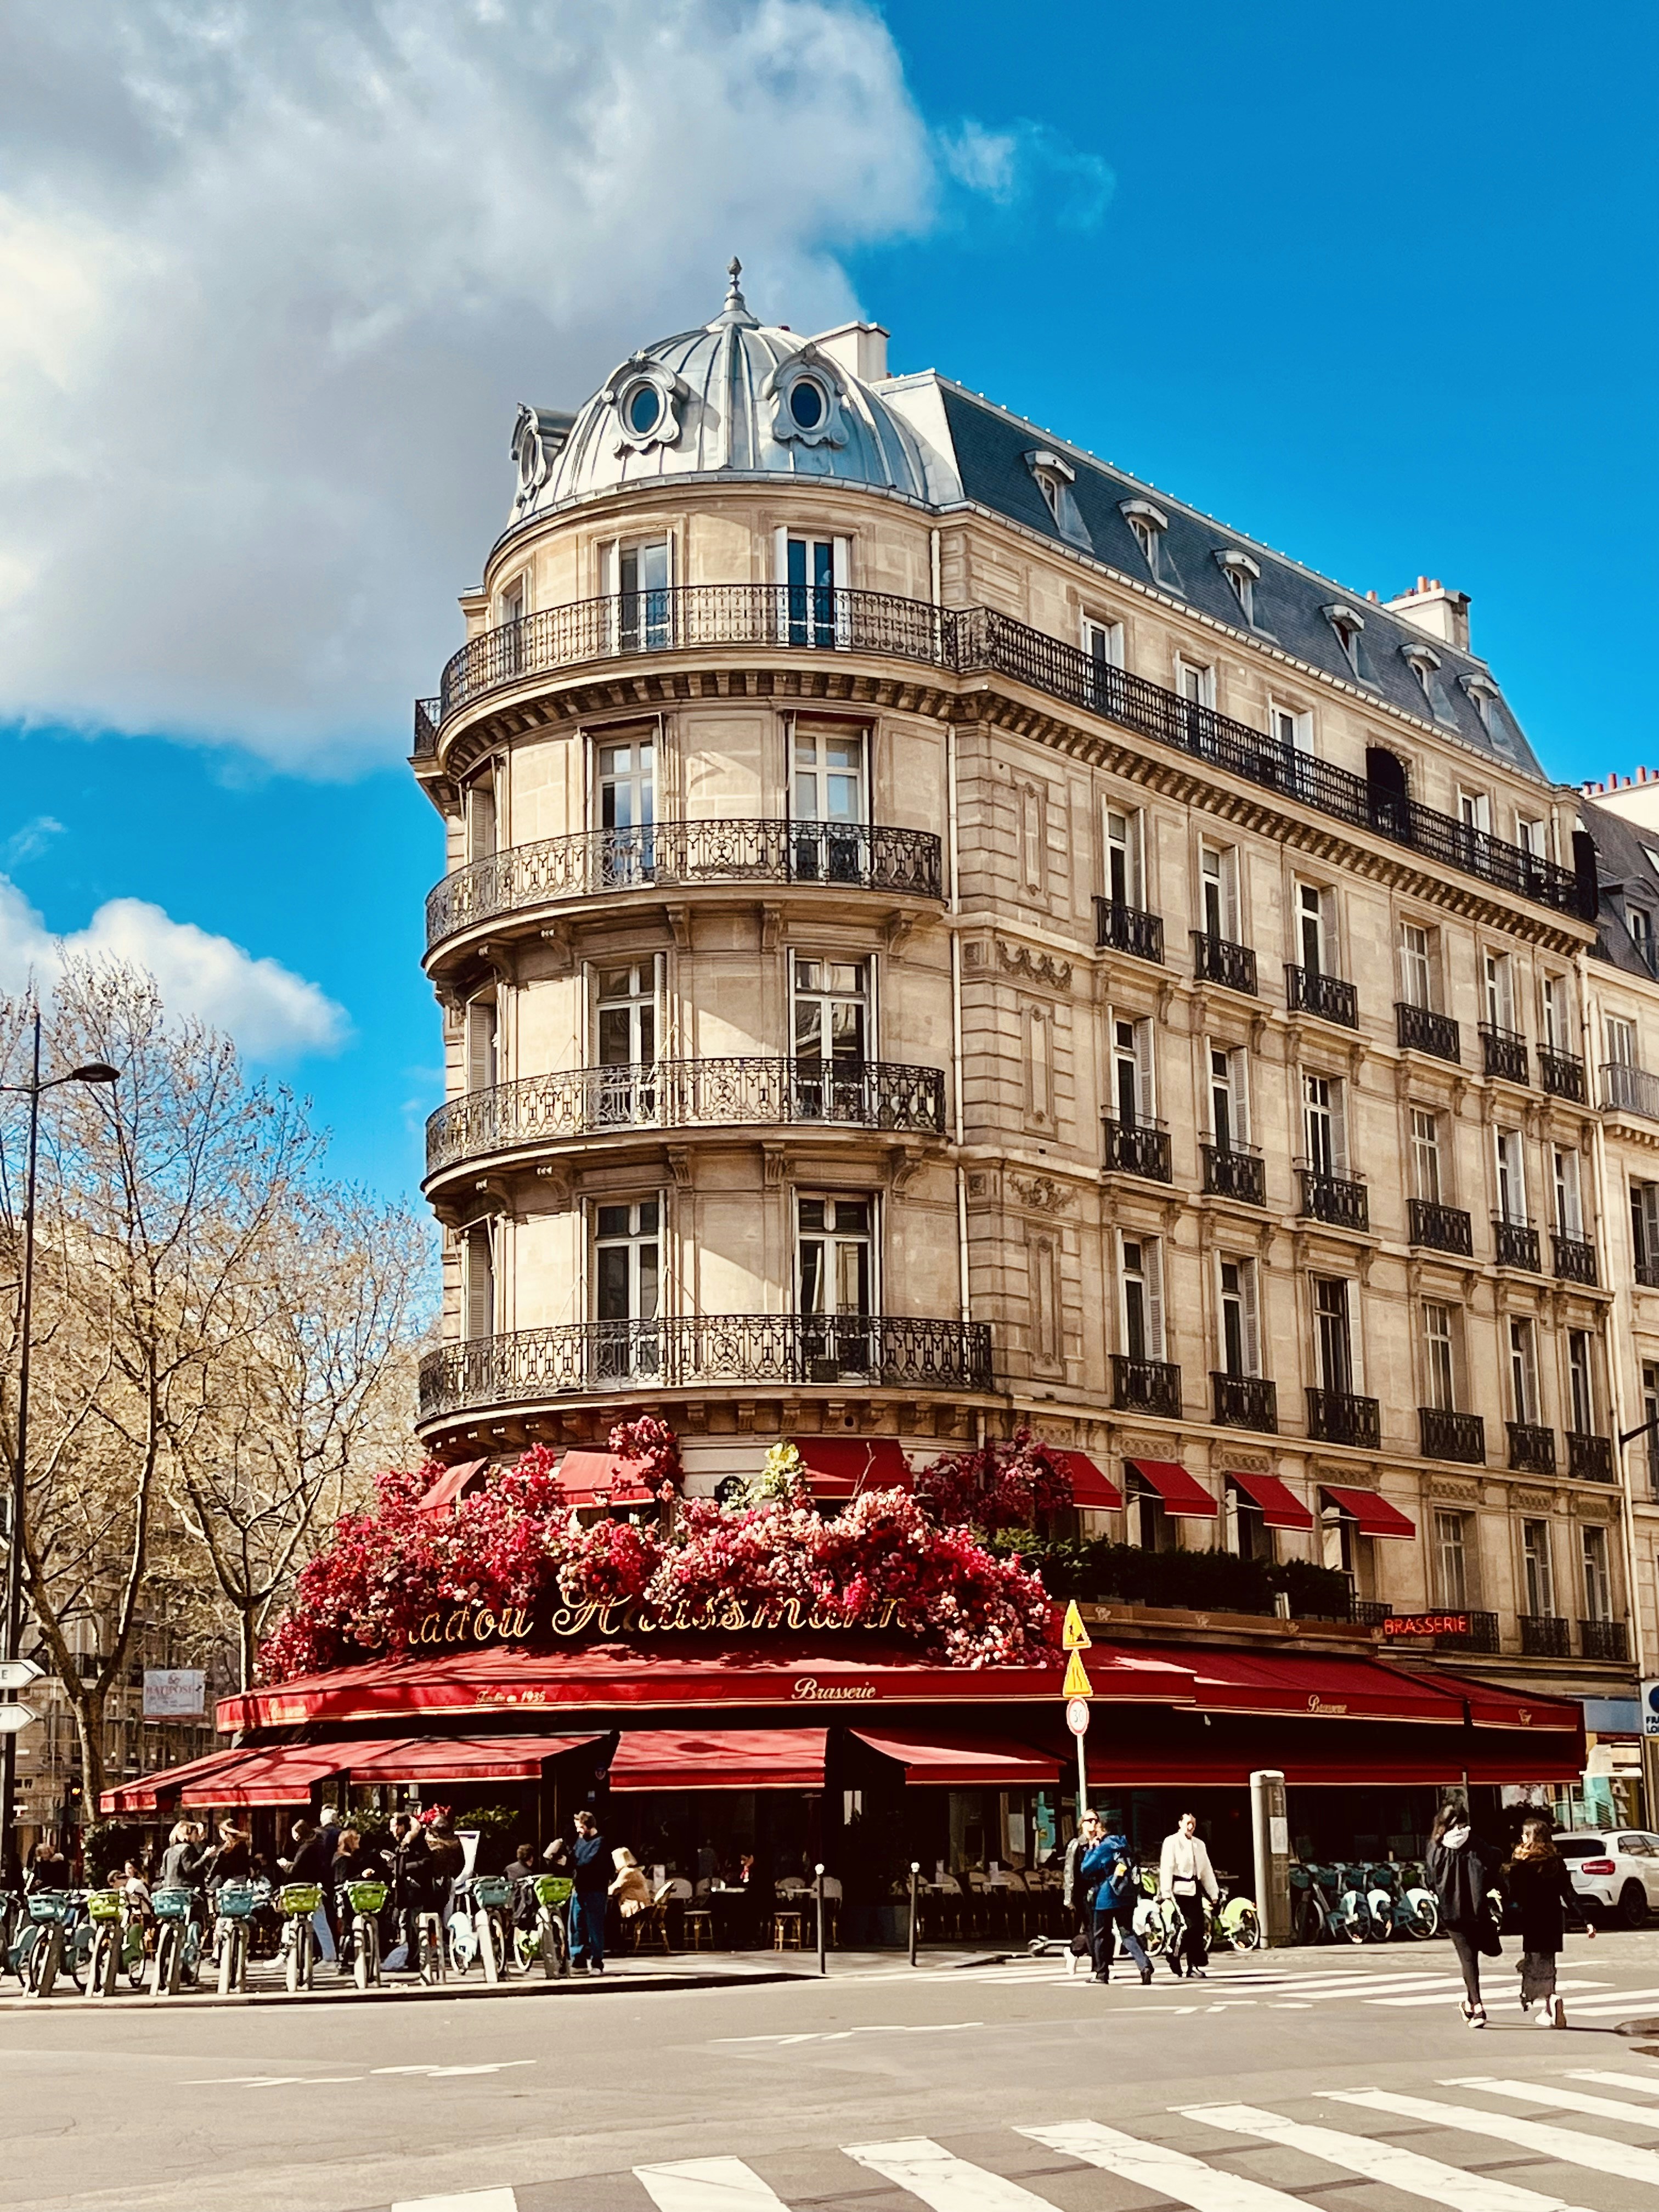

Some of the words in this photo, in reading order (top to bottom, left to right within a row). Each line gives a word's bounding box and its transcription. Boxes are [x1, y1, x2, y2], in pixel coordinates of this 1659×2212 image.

[1384, 1615, 1466, 1635] BRASSERIE
[791, 1677, 876, 1700] Brasserie
[1073, 1709, 1084, 1723] 30
